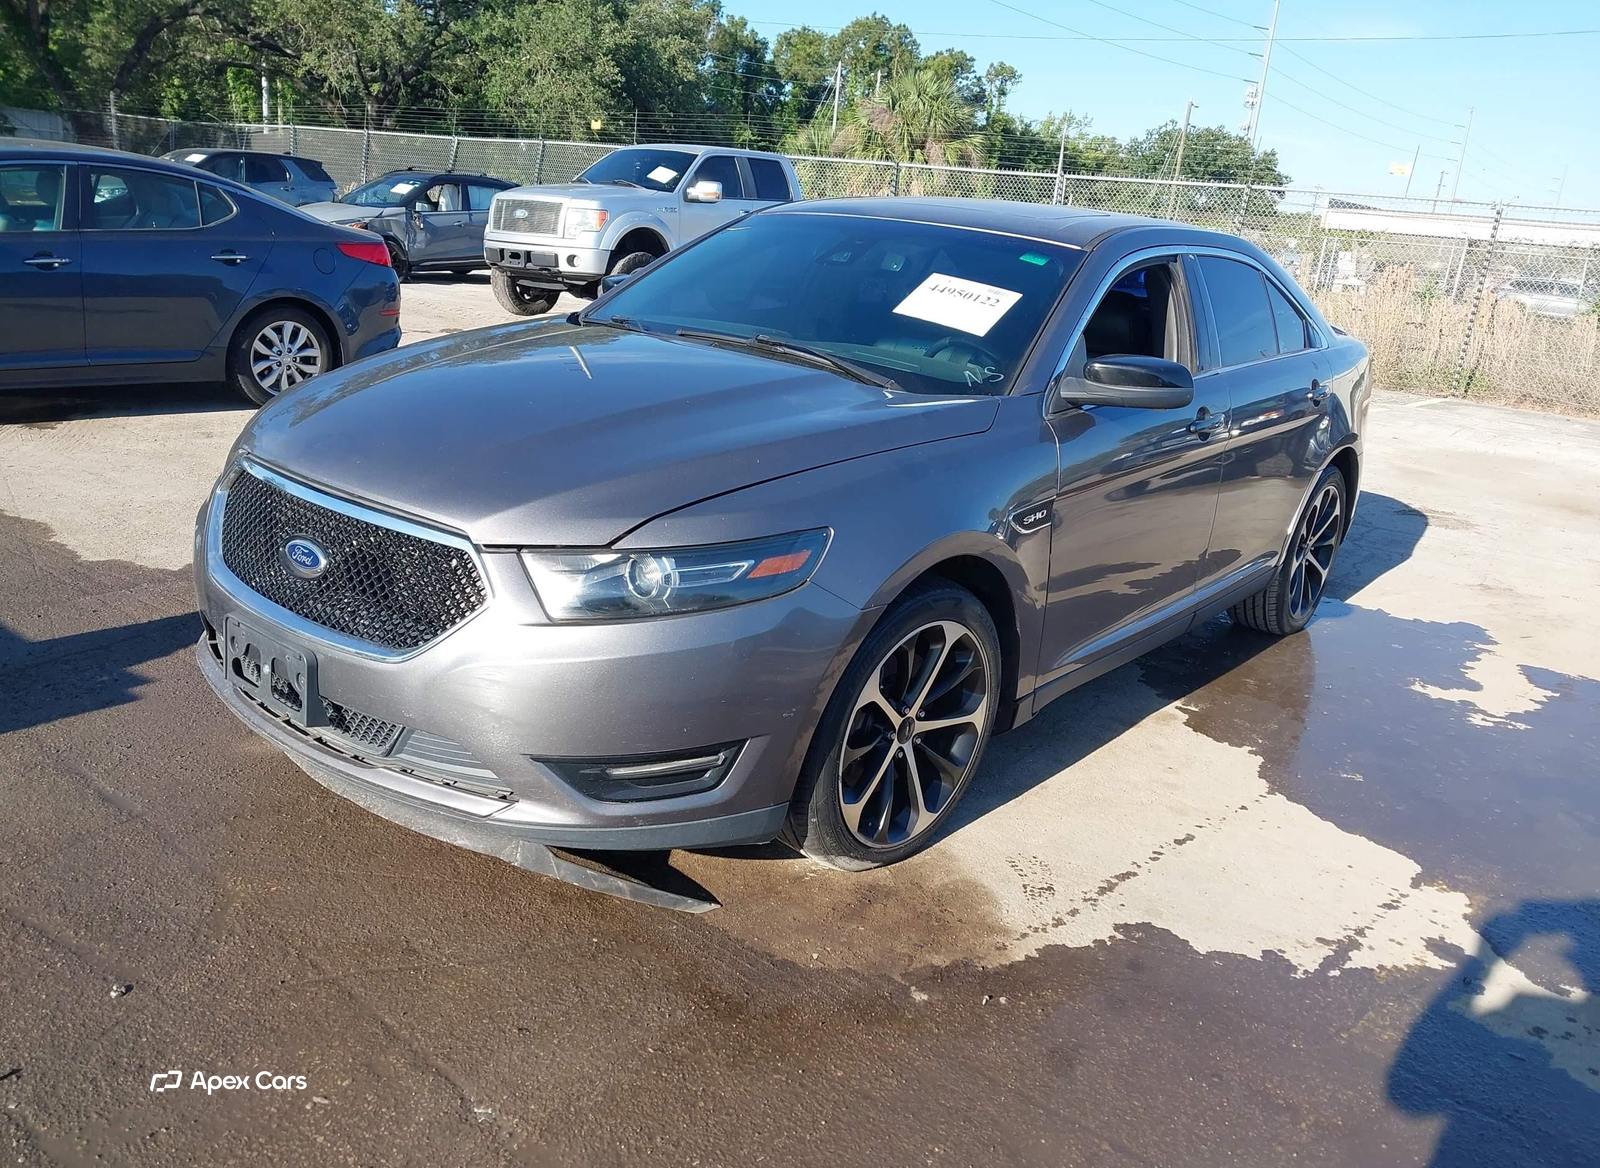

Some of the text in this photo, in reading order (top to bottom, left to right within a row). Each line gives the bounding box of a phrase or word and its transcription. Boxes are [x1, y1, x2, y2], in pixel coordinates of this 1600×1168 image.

[928, 284, 1000, 307] 44950122
[1023, 509, 1047, 525] SHO
[291, 545, 314, 566] Ford
